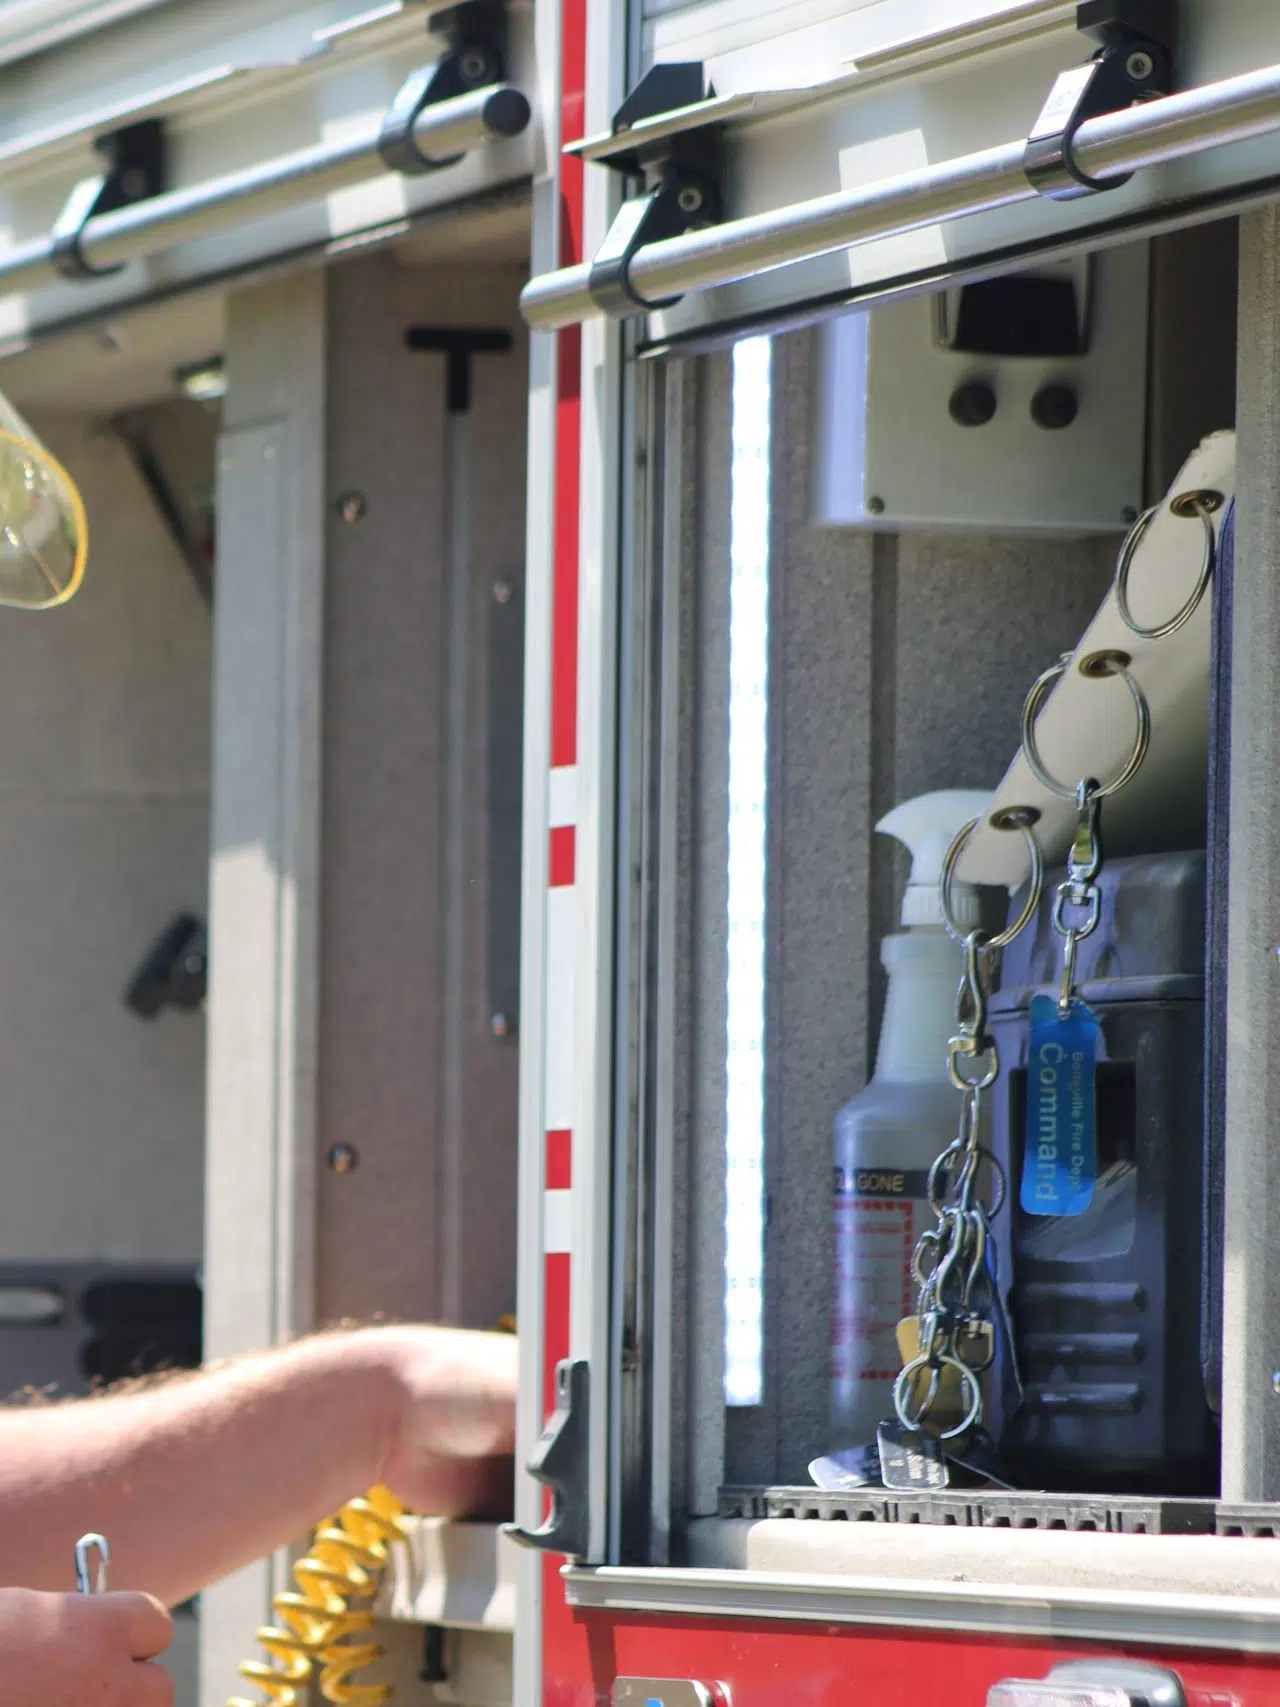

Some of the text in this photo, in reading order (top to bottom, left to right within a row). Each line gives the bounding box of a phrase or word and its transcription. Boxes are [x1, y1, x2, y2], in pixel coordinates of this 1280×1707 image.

[1035, 1042, 1065, 1201] Command
[1071, 1122, 1084, 1151] Fire
[856, 1172, 905, 1194] GONE
